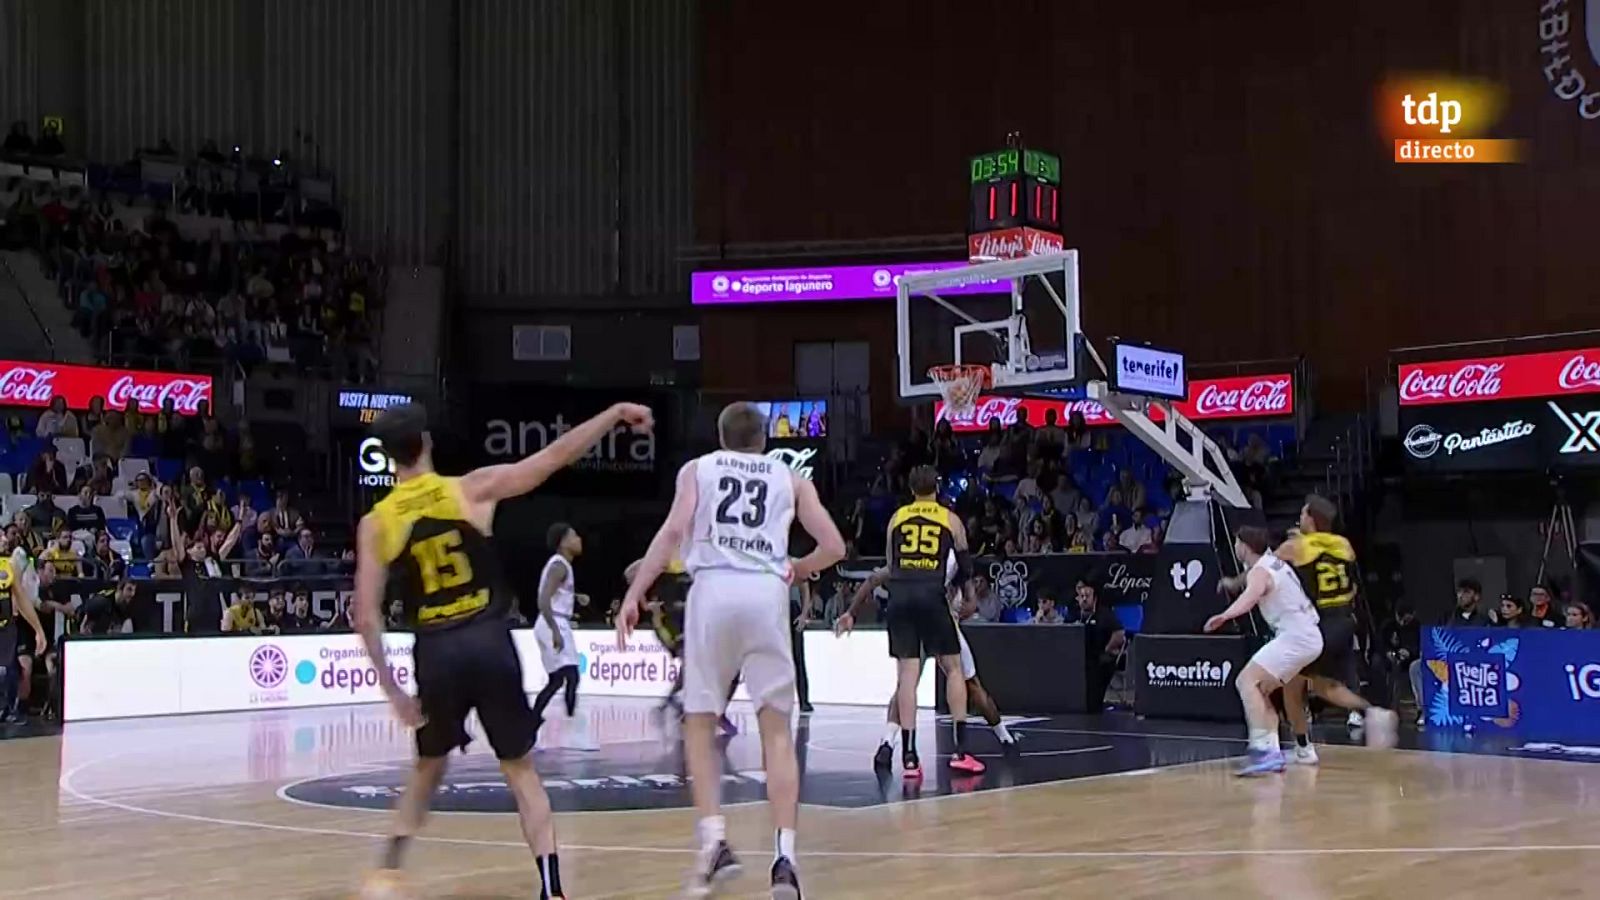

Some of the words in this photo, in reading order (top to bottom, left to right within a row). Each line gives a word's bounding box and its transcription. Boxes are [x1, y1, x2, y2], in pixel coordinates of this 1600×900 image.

[972, 150, 1019, 181] 03:54
[974, 233, 1024, 257] Libby's
[741, 282, 784, 294] deporte
[785, 280, 833, 294] lagunero
[1122, 355, 1179, 386] tenerife!
[339, 392, 368, 407] VISITA
[1443, 420, 1536, 455] Pantástico
[716, 476, 768, 528] 23
[718, 535, 773, 554] PETKIM
[900, 524, 941, 555] 35
[410, 529, 474, 594] 15
[1315, 562, 1350, 592] 21
[1104, 563, 1153, 594] López
[320, 661, 409, 694] depote
[589, 655, 658, 688] deporte
[1146, 661, 1232, 687] tenerife!
